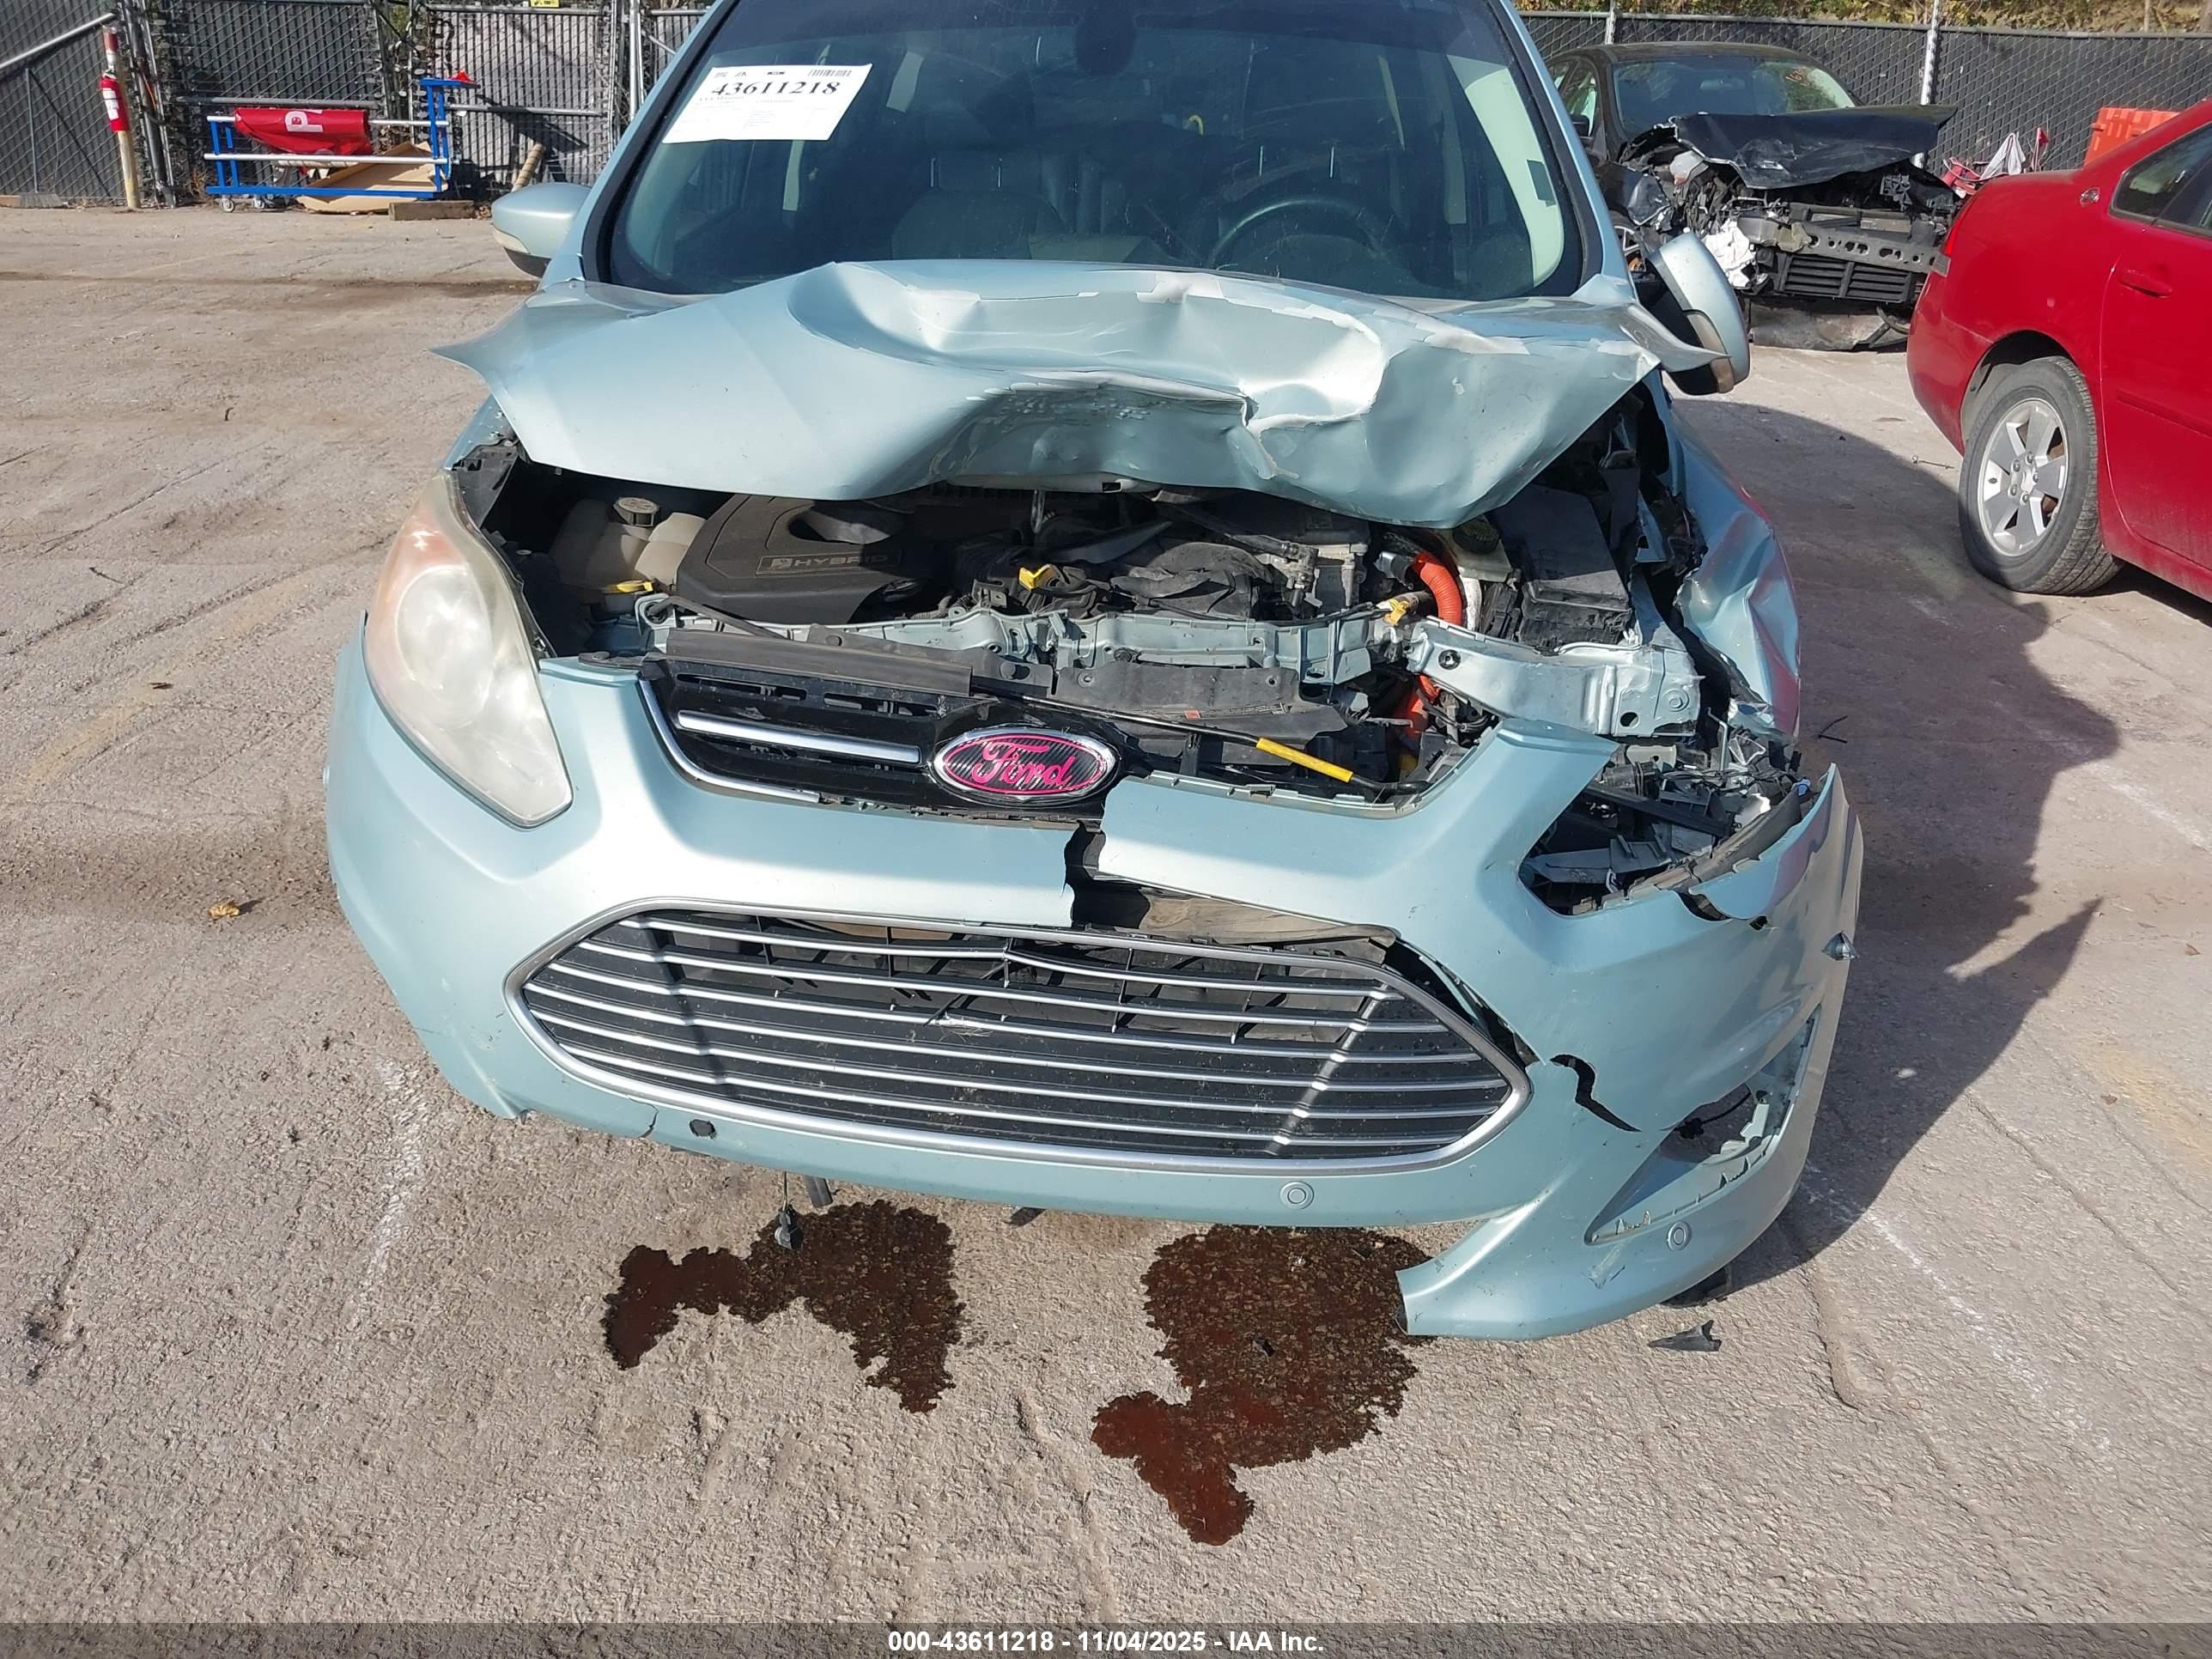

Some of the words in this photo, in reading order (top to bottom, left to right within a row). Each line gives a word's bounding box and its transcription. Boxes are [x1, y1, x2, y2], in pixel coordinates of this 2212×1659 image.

[712, 81, 841, 96] 43611218
[793, 555, 889, 567] HYBRID
[971, 740, 1076, 784] Ford
